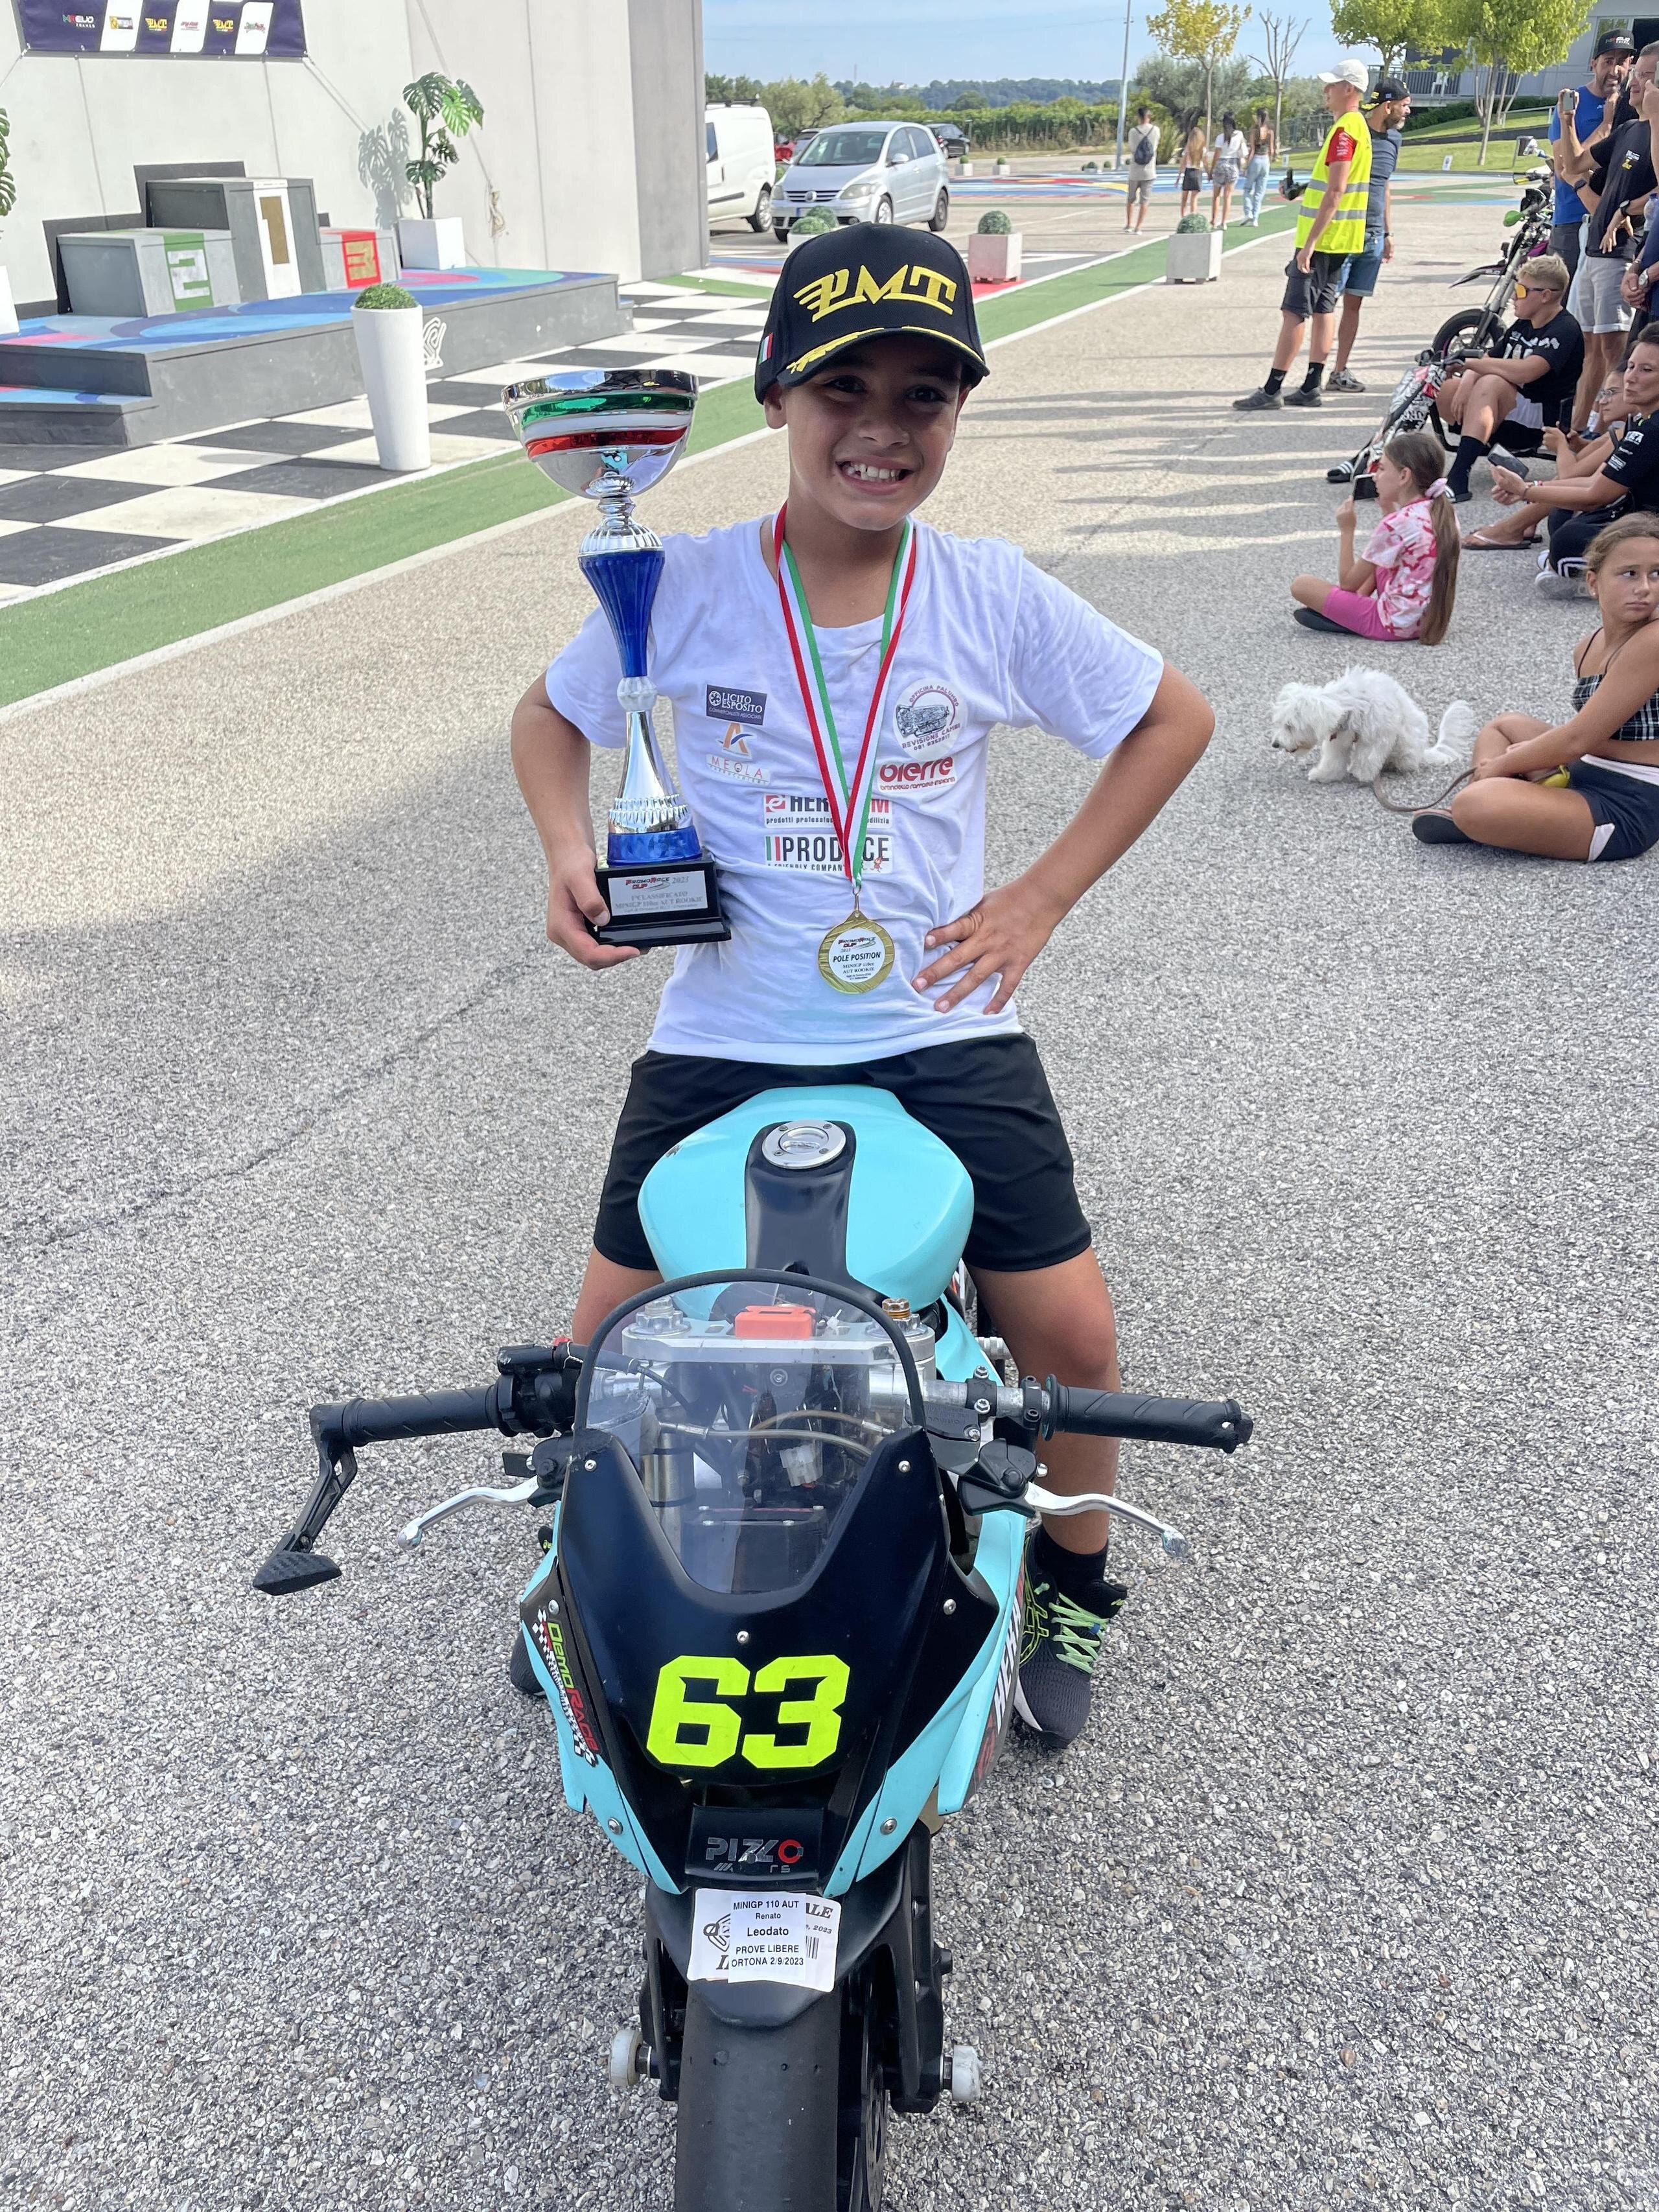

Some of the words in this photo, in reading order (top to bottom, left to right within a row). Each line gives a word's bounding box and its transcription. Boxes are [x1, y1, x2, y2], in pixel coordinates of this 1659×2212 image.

[345, 240, 377, 279] 3
[167, 250, 210, 299] 2
[793, 264, 957, 323] PMT
[722, 692, 752, 704] LICITO
[909, 685, 934, 703] OFFICINA
[936, 685, 959, 707] PALUMBO
[721, 700, 763, 714] ESPOSITO
[901, 733, 939, 749] REVISIONE
[942, 723, 960, 735] CAMBI
[712, 756, 763, 778] MEOLA
[782, 836, 889, 861] PRODCE
[851, 951, 881, 961] POSITION
[647, 1655, 850, 1768] 63
[733, 1901, 763, 1910] MINIGP
[765, 1900, 780, 1909] 110
[782, 1900, 799, 1909] AUT
[747, 1927, 789, 1937] Leodato
[813, 1924, 833, 1935] 2023
[736, 1945, 765, 1954] PROVE
[731, 1957, 767, 1967] ORTONA
[770, 1957, 804, 1966] 2/9/2023
